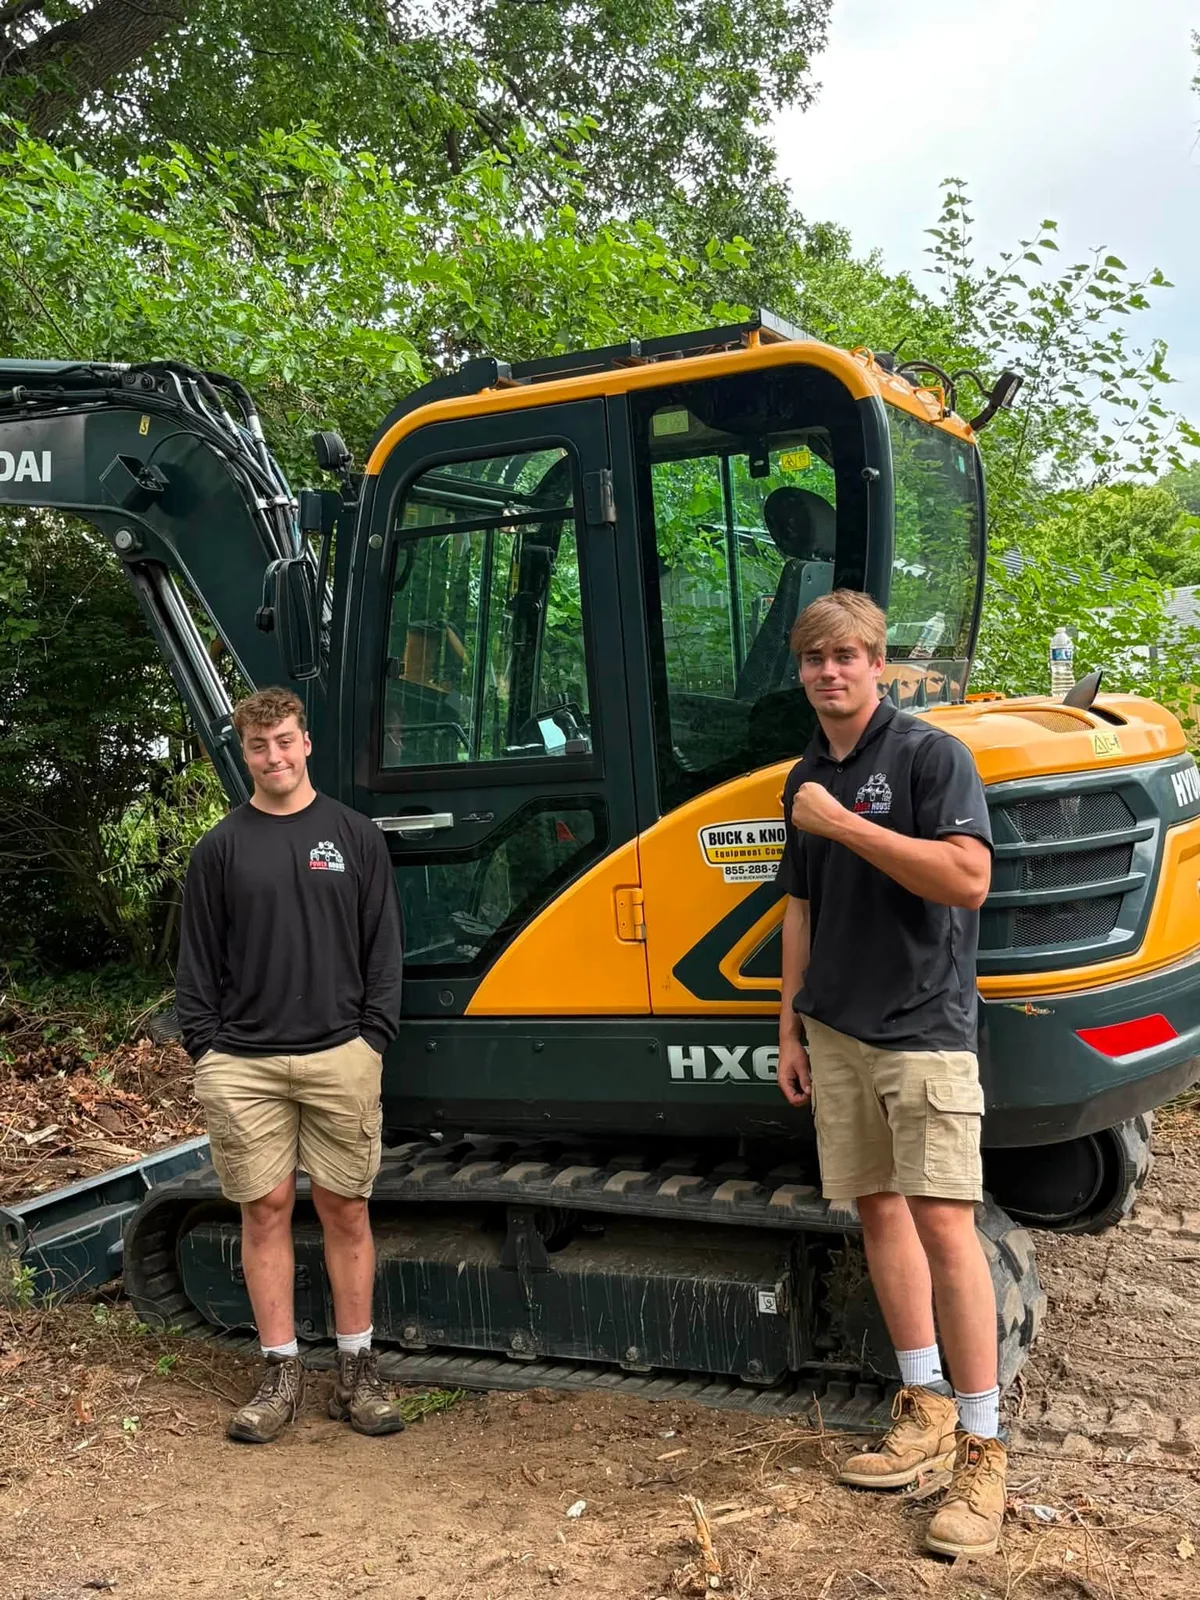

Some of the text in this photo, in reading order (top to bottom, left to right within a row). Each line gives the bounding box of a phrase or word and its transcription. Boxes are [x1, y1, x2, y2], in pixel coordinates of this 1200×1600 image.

[871, 802, 891, 811] HOUSE
[708, 828, 786, 846] BUCK & KNO
[715, 847, 783, 858] Equipment Com
[725, 864, 780, 875] 855-288-2
[667, 1045, 779, 1080] HX6
